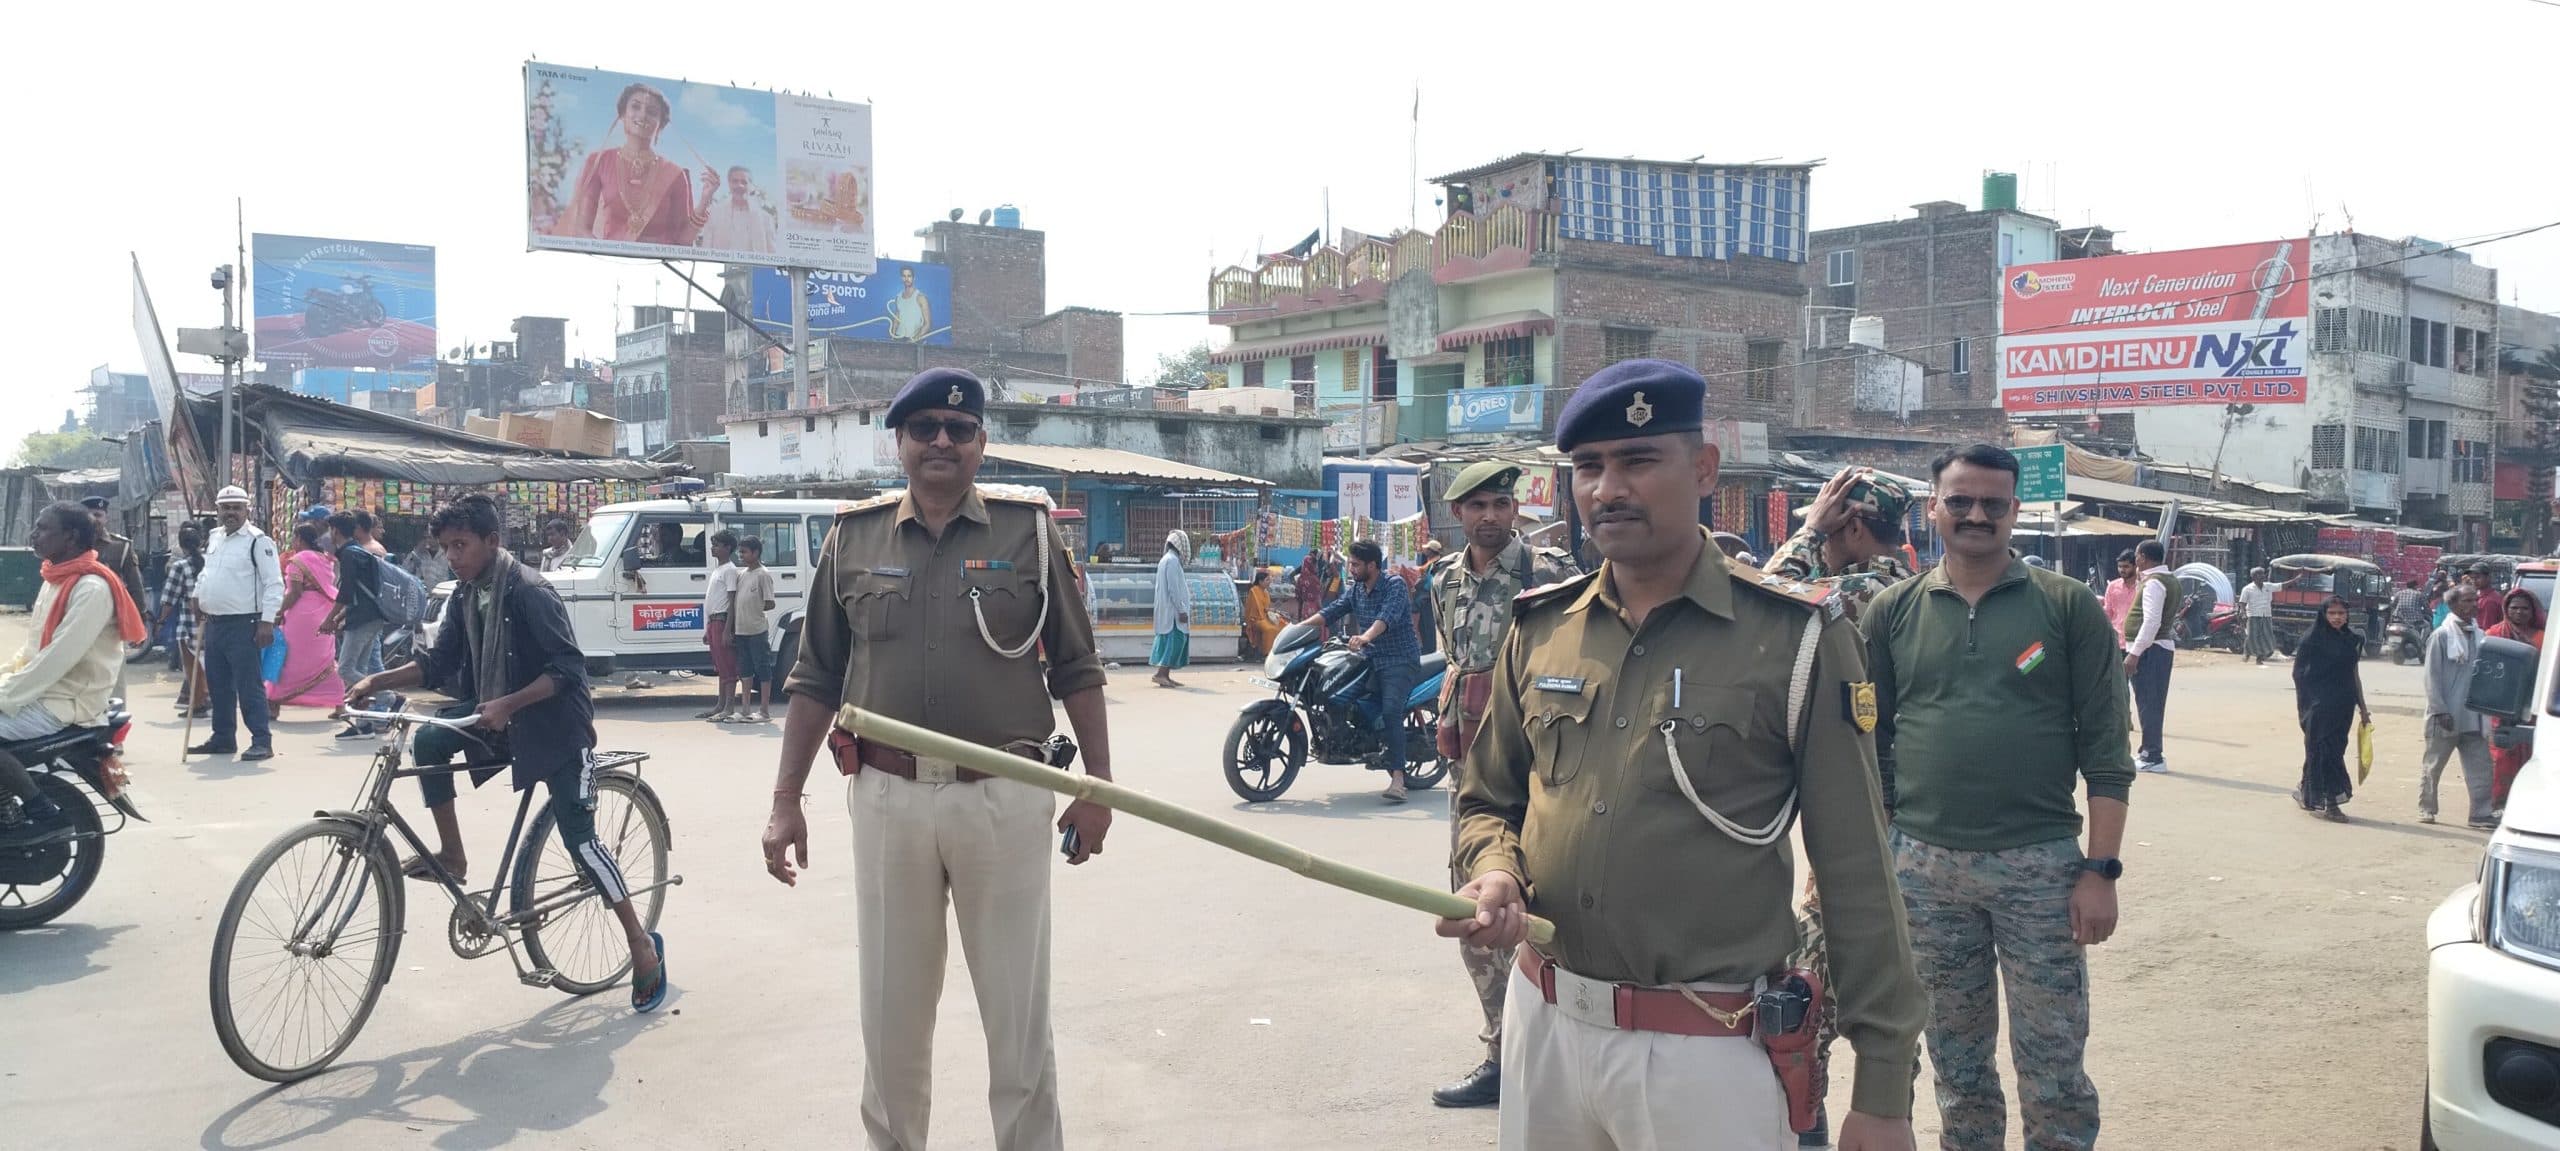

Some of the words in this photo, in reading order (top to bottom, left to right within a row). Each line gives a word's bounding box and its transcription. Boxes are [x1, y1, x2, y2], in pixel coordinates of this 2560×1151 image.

[536, 69, 559, 79] TATA
[294, 243, 366, 270] MOTORCYCLING
[822, 283, 867, 299] SPORTO
[2100, 277, 2140, 298] Next
[2143, 269, 2237, 294] Generation
[831, 304, 846, 315] HAI
[2070, 300, 2181, 326] INTERLOCK
[2183, 295, 2229, 319] Steel
[2008, 340, 2187, 374] KAMDHENU
[2193, 320, 2299, 377] Nxt
[2035, 386, 2134, 404] SHIVSHIVA
[2140, 383, 2197, 399] STEEL
[2203, 382, 2247, 397] PVT.
[2252, 380, 2298, 396] LTD.
[1466, 396, 1507, 418] OREO
[673, 607, 701, 619] थाना
